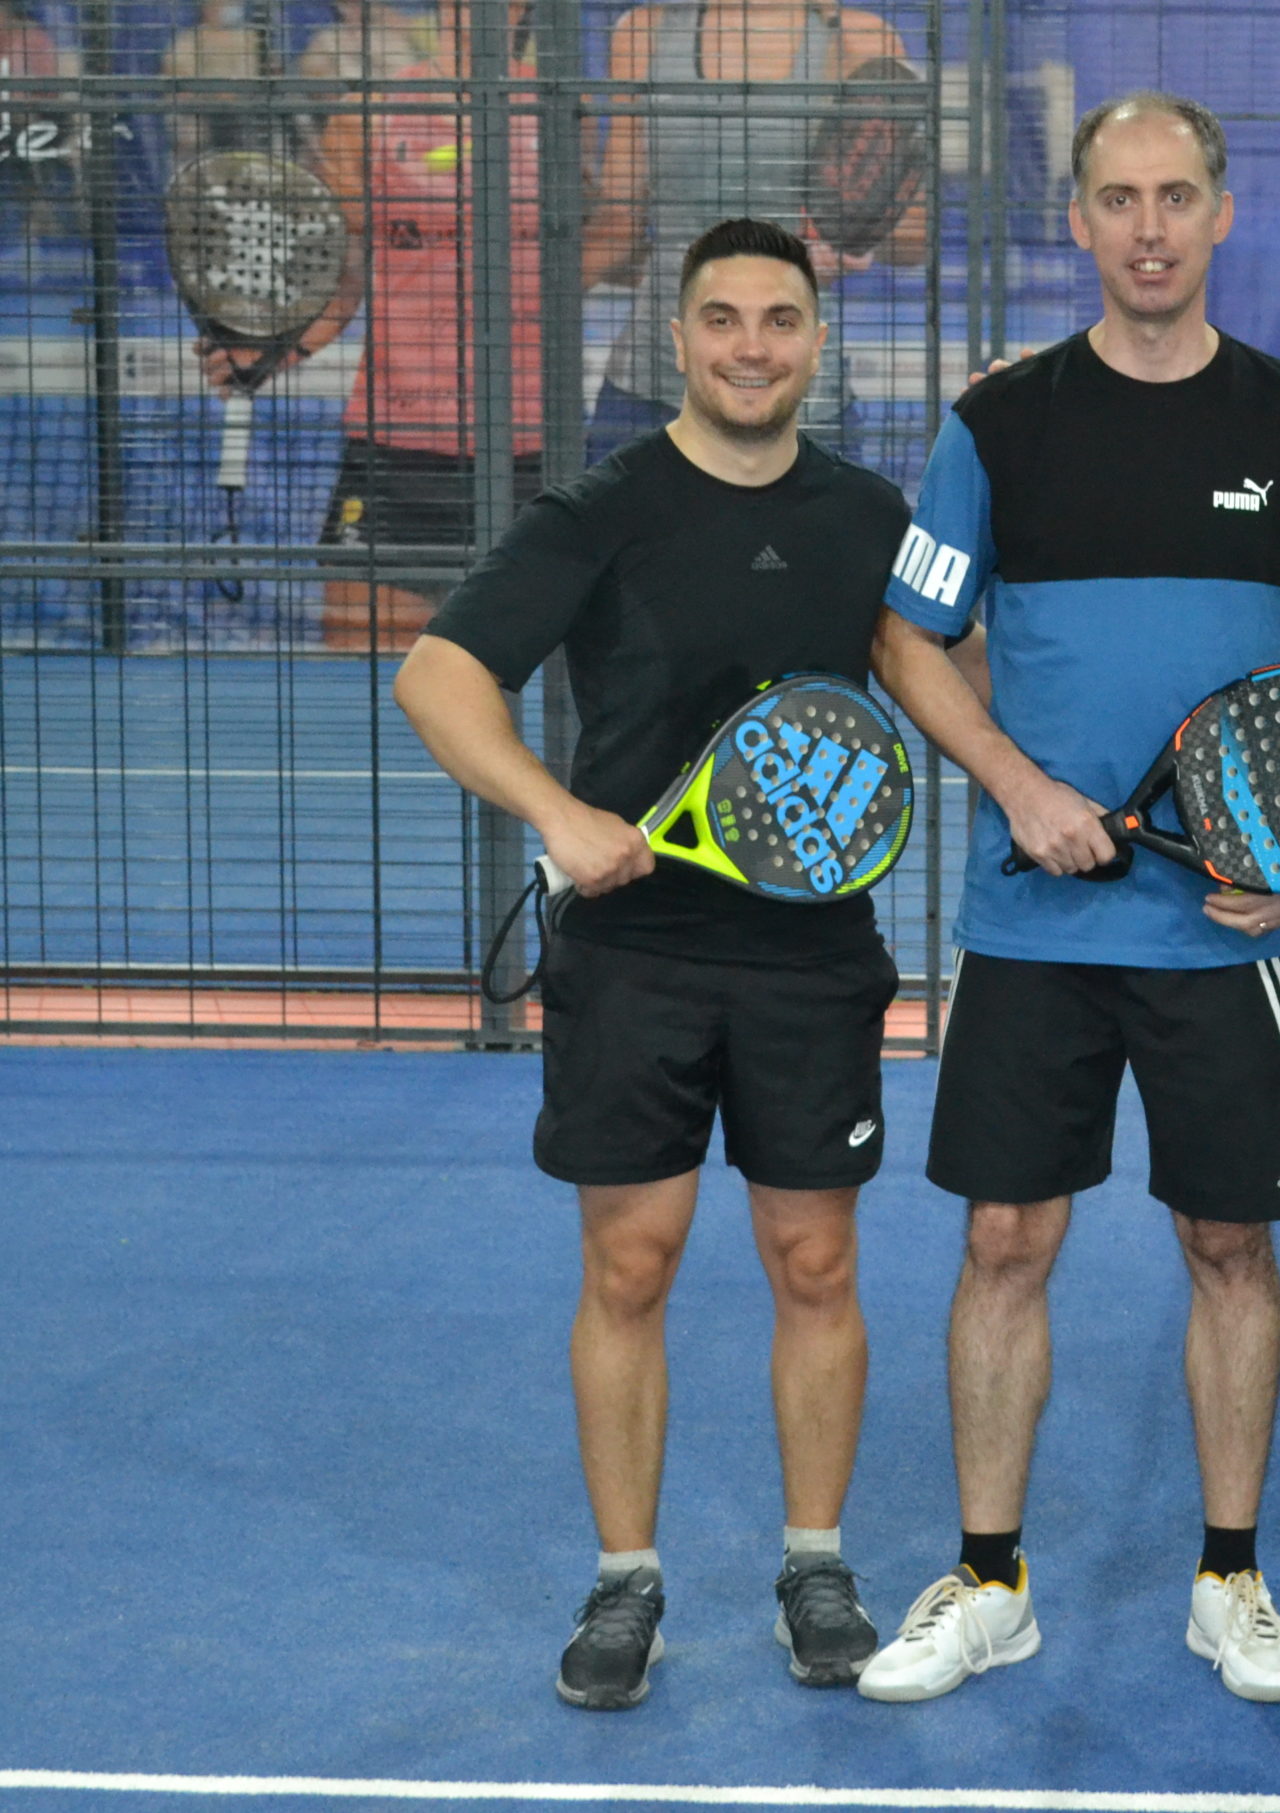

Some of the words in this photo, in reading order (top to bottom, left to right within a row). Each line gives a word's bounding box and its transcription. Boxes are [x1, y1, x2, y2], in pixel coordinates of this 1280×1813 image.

[1213, 490, 1260, 512] PUMA
[892, 523, 971, 608] MA
[892, 742, 910, 774] DRIVE
[734, 720, 844, 895] adidas
[1190, 773, 1209, 818] KUIKMA
